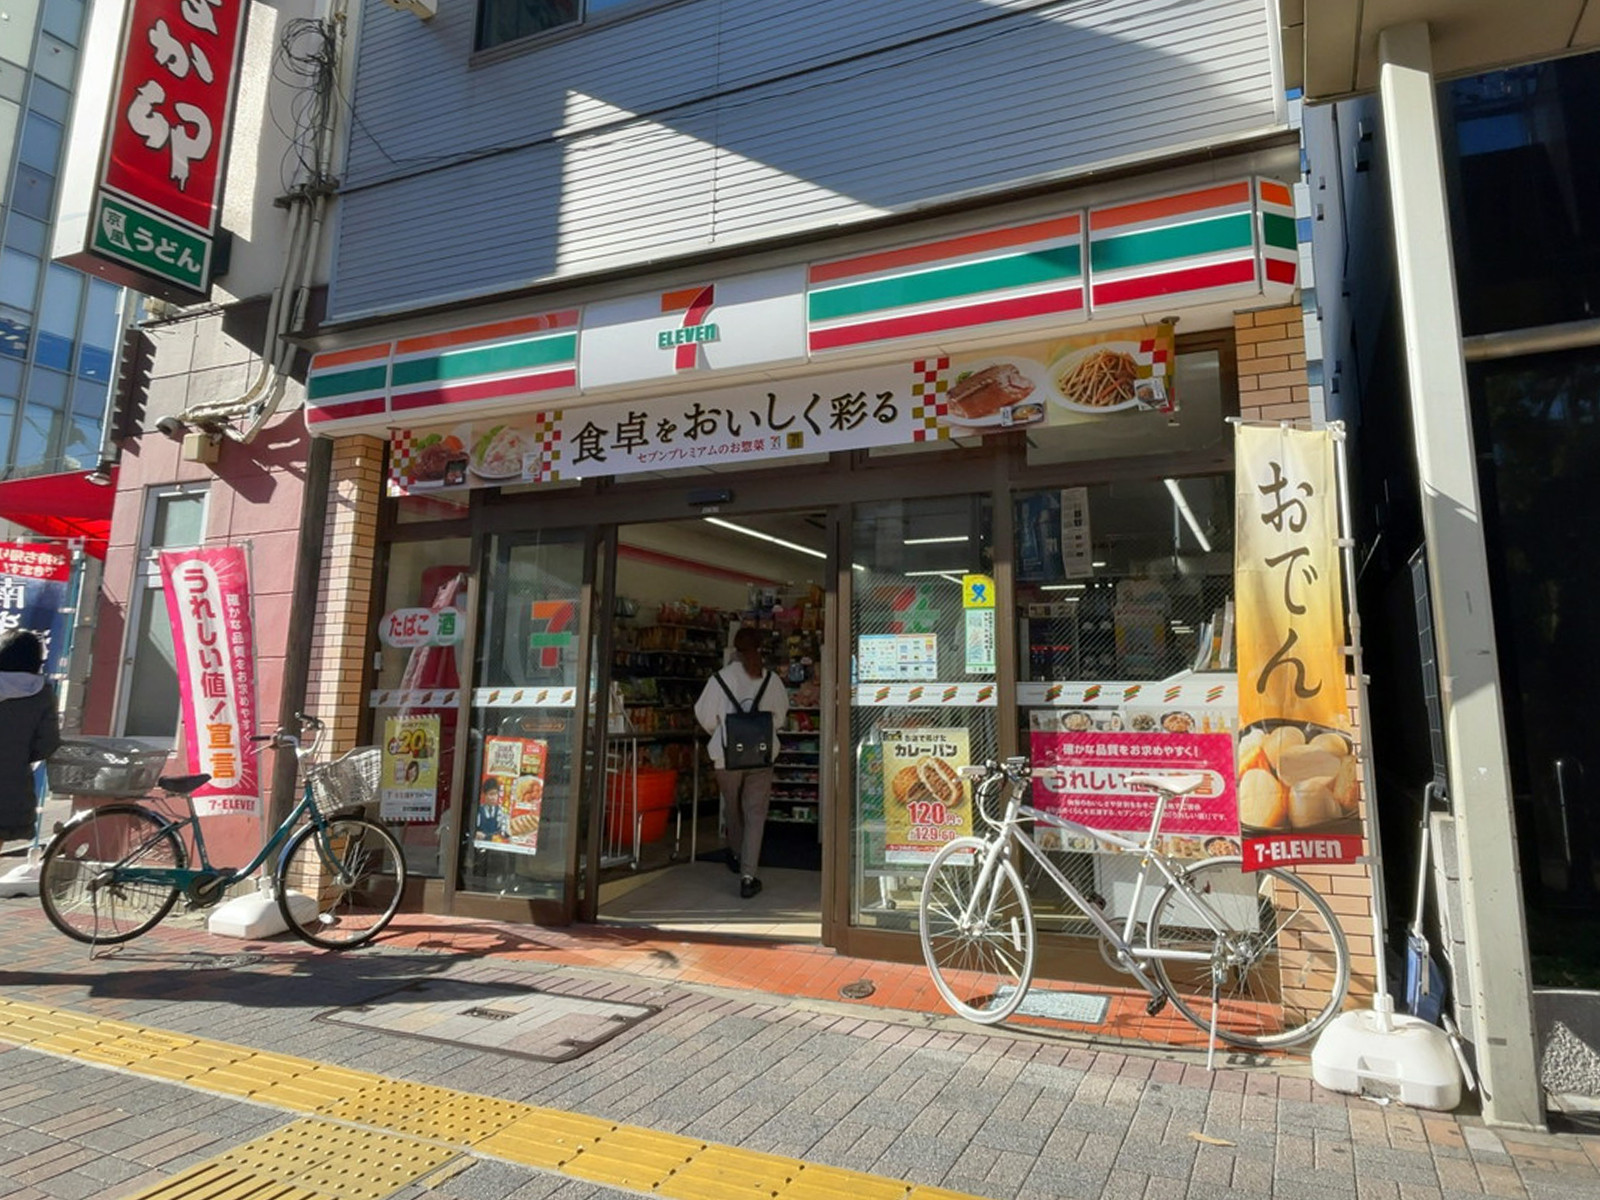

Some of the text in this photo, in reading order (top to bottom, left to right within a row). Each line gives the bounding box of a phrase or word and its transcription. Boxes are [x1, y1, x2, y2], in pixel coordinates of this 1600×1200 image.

[133, 226, 201, 273] うどん
[661, 284, 715, 372] 7
[570, 390, 898, 465] 食卓をおいしく彩る
[637, 438, 765, 463] セブンプレミアムのお惣菜
[1255, 460, 1323, 700] おでん
[389, 612, 457, 637] たばこ 酒
[182, 568, 236, 780] うれしい値!宣言
[895, 743, 958, 757] カレーパン
